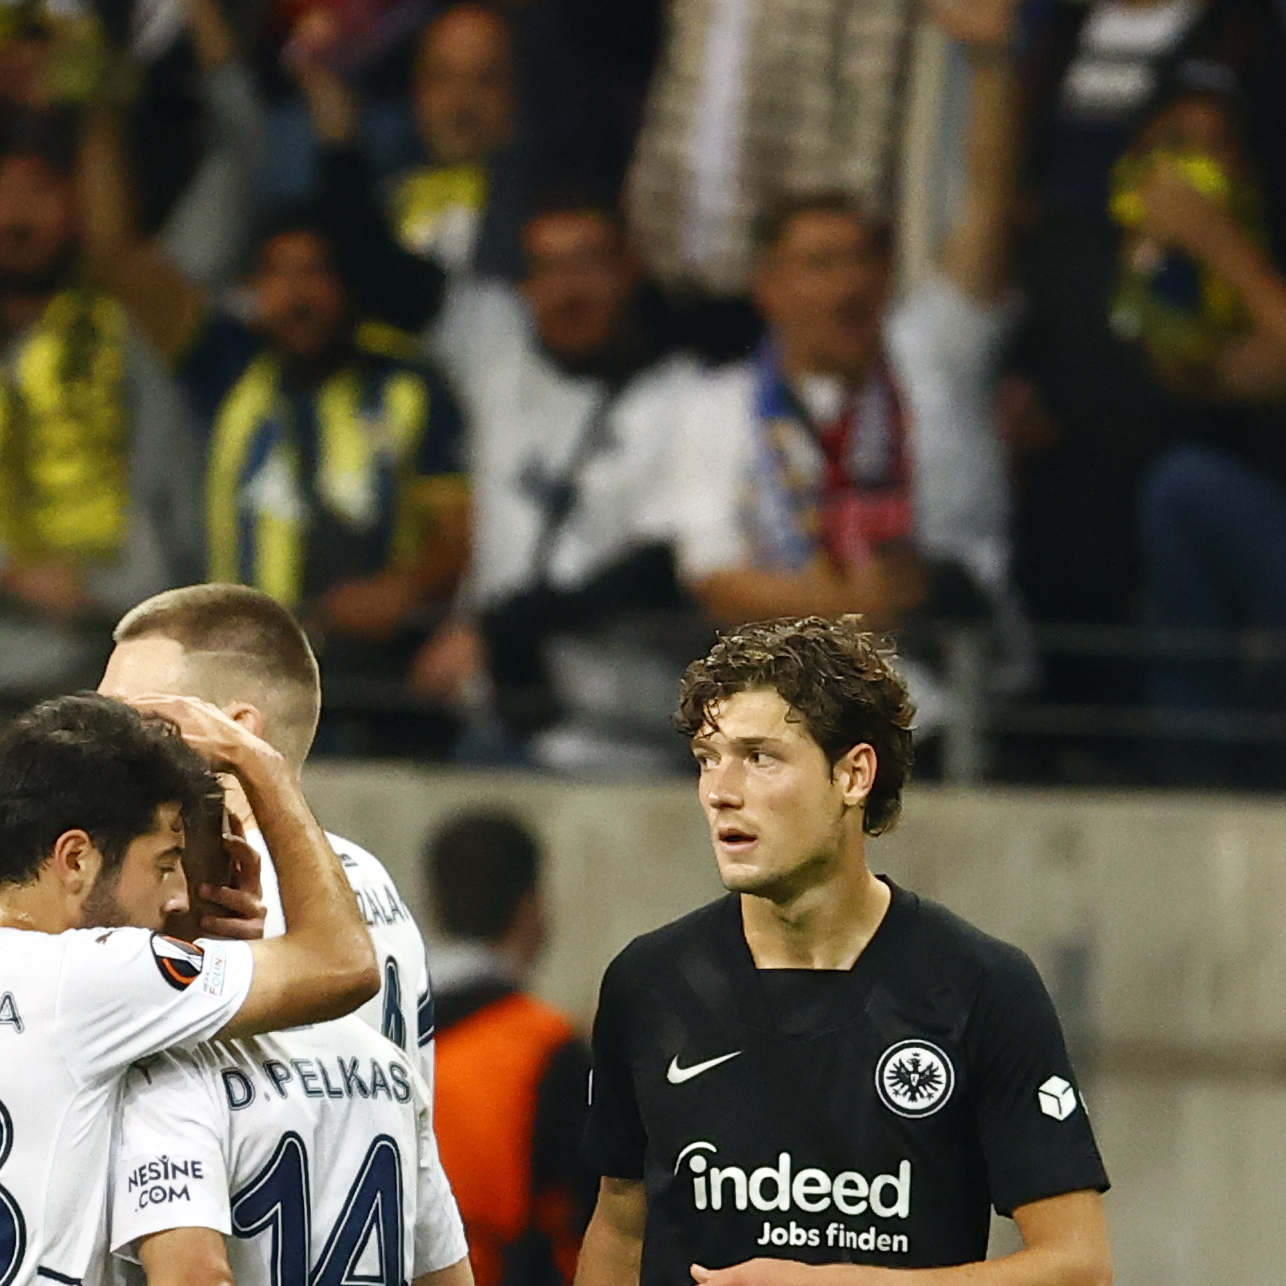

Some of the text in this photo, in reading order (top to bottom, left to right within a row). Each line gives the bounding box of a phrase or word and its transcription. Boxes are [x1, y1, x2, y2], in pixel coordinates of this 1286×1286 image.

[674, 1142, 912, 1219] indeed
[134, 1184, 191, 1212] .COM
[757, 1221, 909, 1252] Jobs finden
